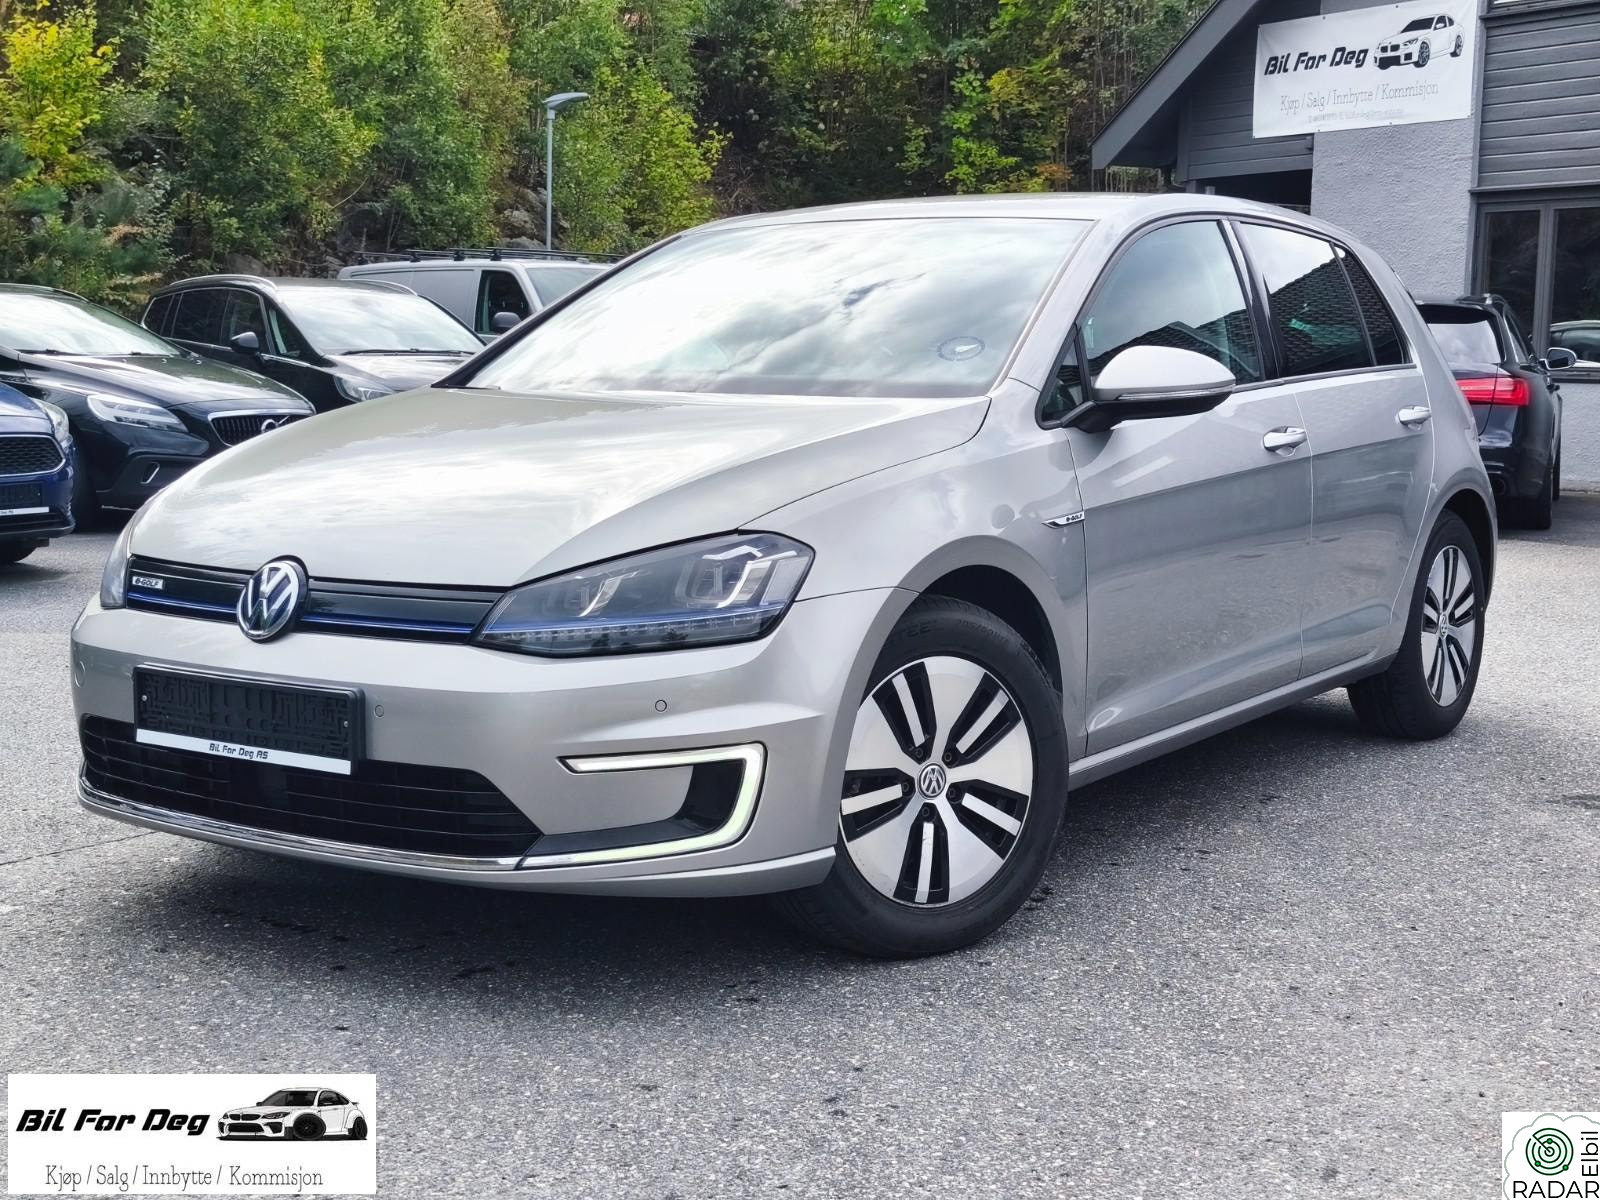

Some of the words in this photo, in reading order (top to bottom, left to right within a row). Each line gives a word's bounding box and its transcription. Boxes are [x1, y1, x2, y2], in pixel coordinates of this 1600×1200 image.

[1264, 52, 1292, 76] Bil
[1293, 51, 1327, 72] For
[1329, 46, 1370, 69] Deg
[1306, 91, 1325, 112] Salg
[1333, 87, 1374, 109] Innbytte
[1381, 80, 1439, 101] Kommisjon
[209, 742, 220, 753] Bil
[222, 744, 236, 755] For
[239, 747, 254, 760] Deg
[256, 750, 269, 760] AS
